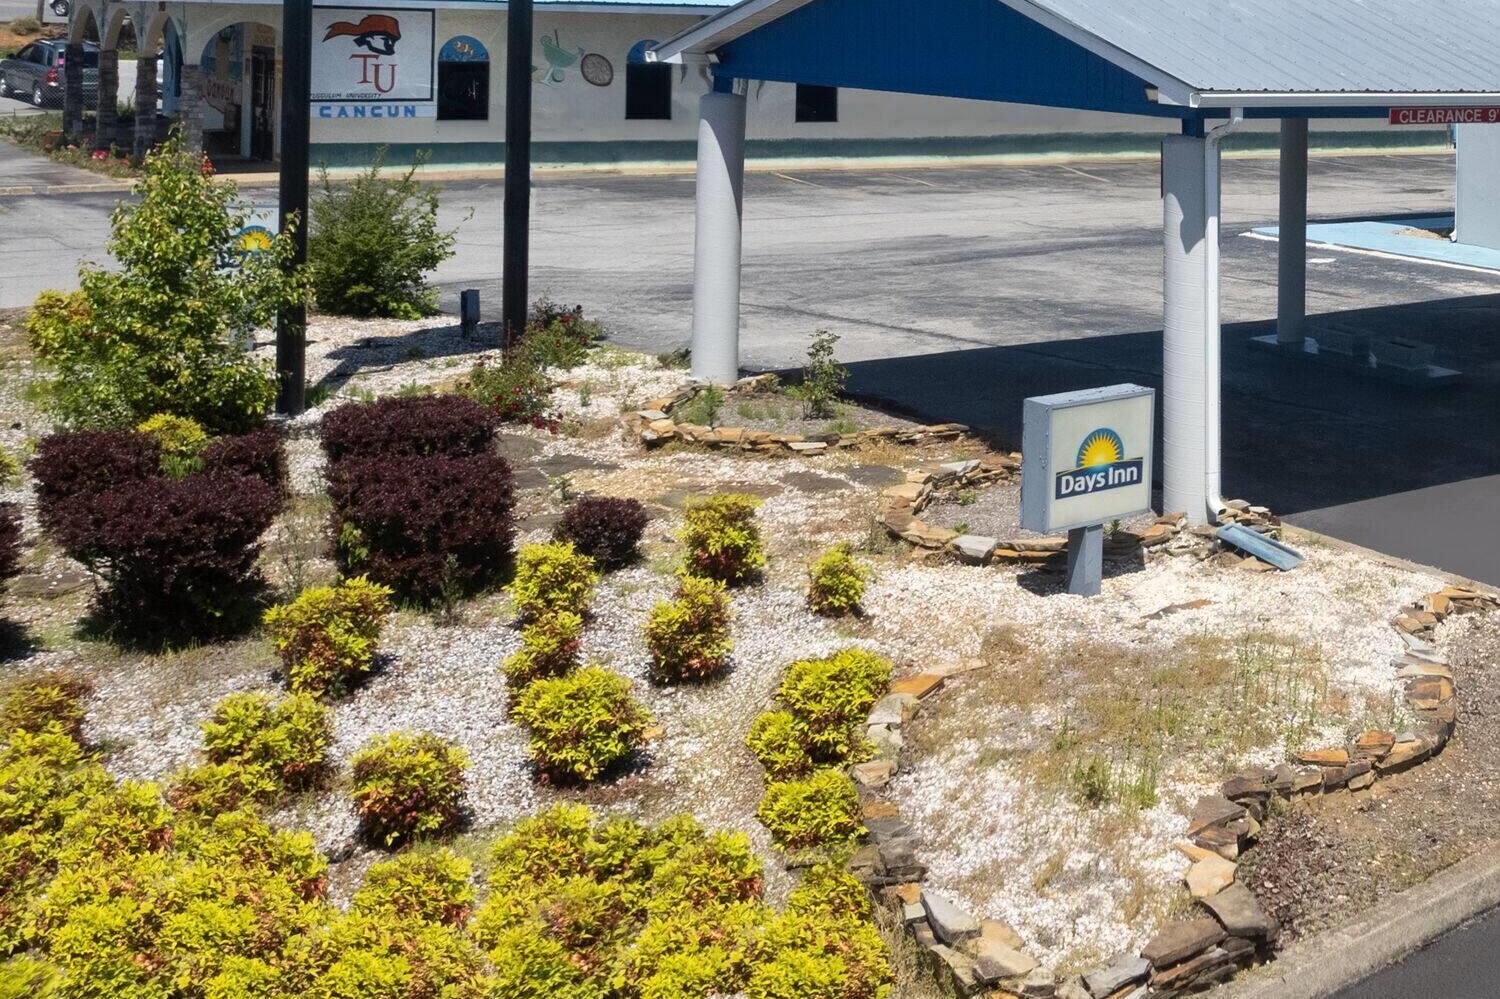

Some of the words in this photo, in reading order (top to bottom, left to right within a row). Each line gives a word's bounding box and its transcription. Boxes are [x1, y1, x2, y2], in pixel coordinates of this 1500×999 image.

[349, 54, 398, 93] TU
[319, 105, 417, 118] CANCUN
[1400, 109, 1482, 123] CLEARANCE
[1488, 108, 1500, 122] 9'
[1060, 472, 1105, 495] Days
[1108, 465, 1138, 485] Inn
